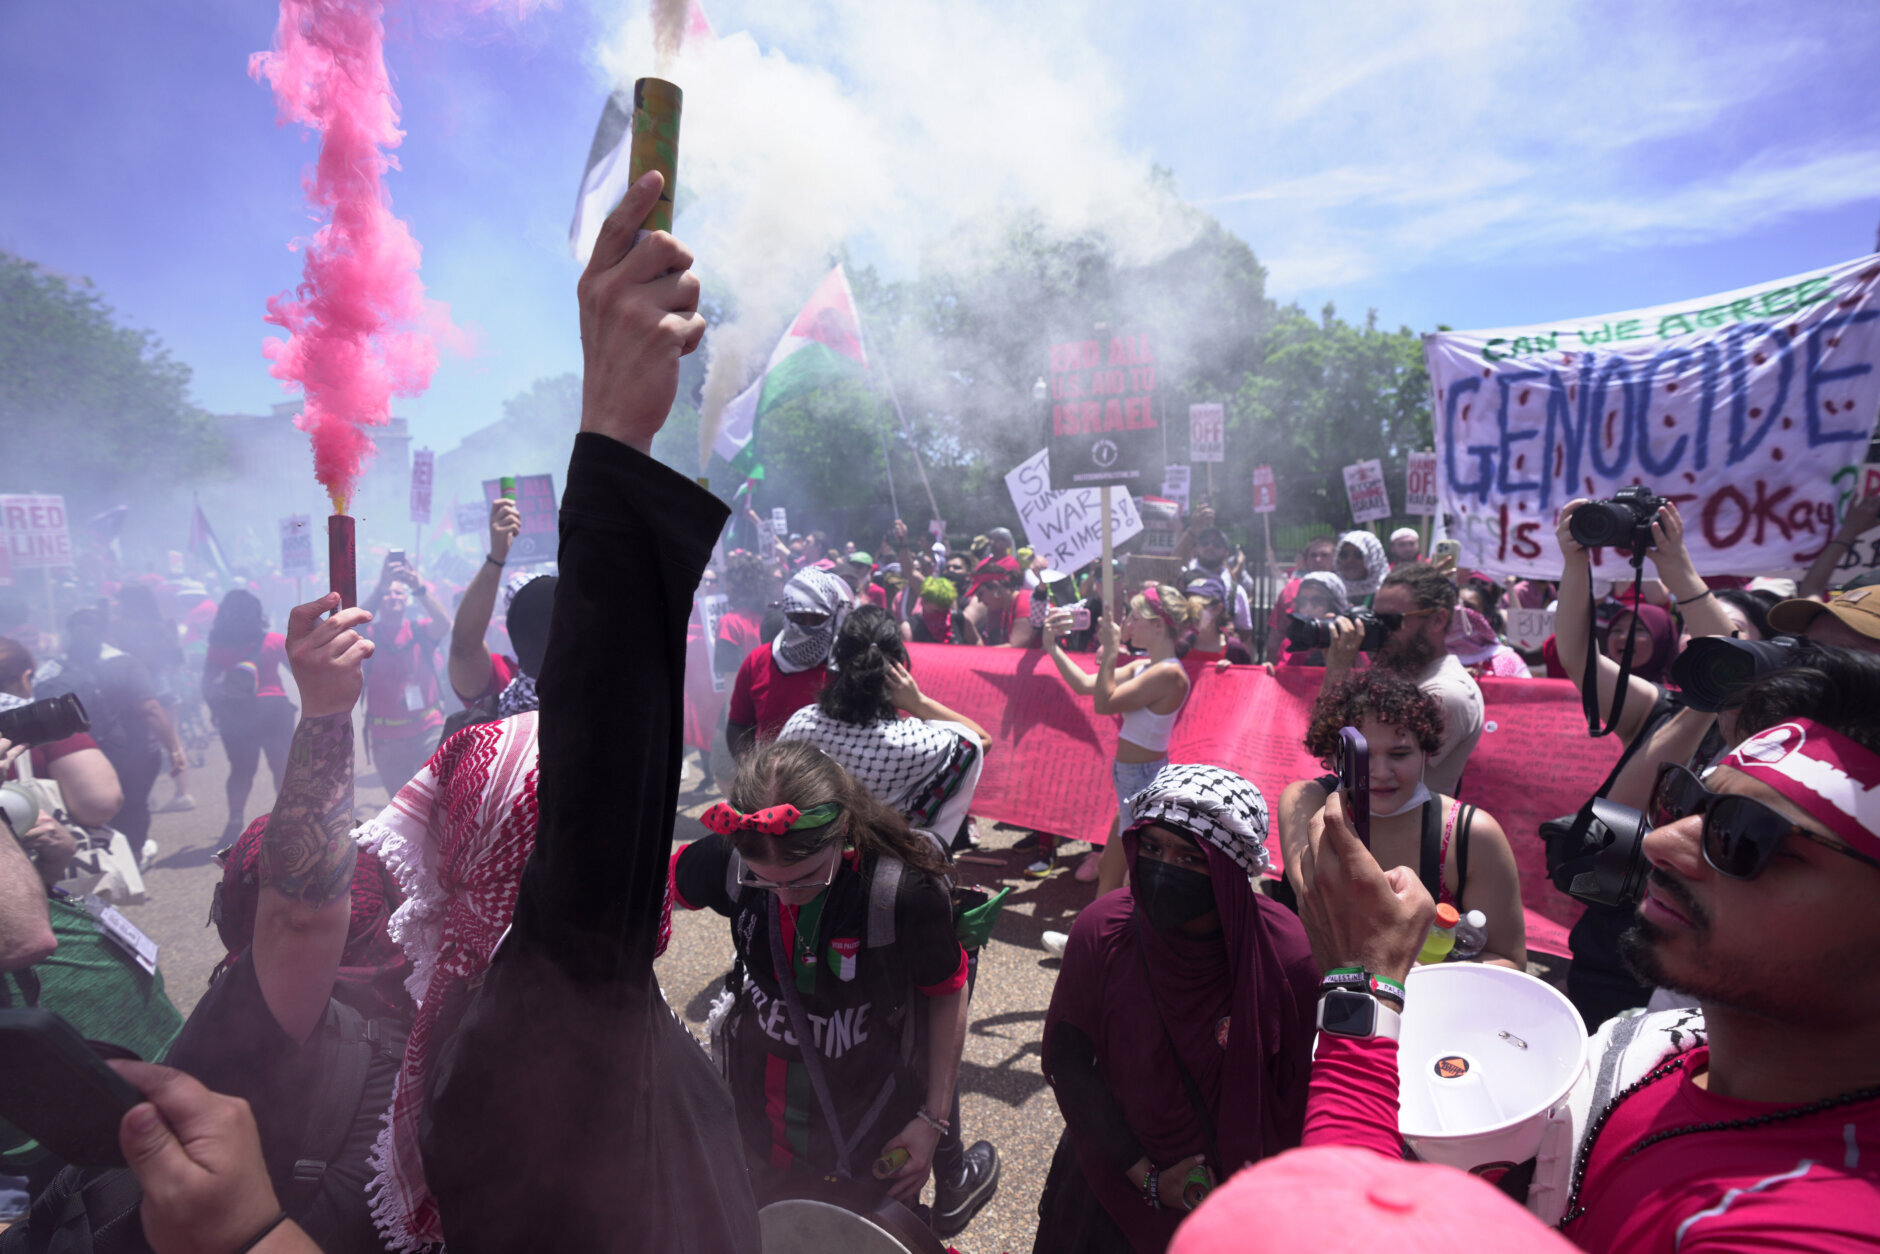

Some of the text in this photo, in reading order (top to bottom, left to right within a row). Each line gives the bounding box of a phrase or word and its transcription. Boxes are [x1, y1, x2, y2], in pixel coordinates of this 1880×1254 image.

[1482, 276, 1836, 362] CAN WE AGREE
[1050, 334, 1155, 373] END ALL
[1052, 367, 1155, 400] U.S. AID TO
[1053, 396, 1158, 436] ISRAEL
[1445, 310, 1880, 510] GENOCIDE
[1191, 421, 1222, 442] OFF
[1018, 453, 1049, 496] ST
[1409, 459, 1437, 470] HAND
[1408, 471, 1437, 494] OF
[5, 506, 66, 529] RED
[1038, 490, 1101, 540] WAR
[10, 535, 70, 557] LINE
[1328, 972, 1364, 983] PALESTINE
